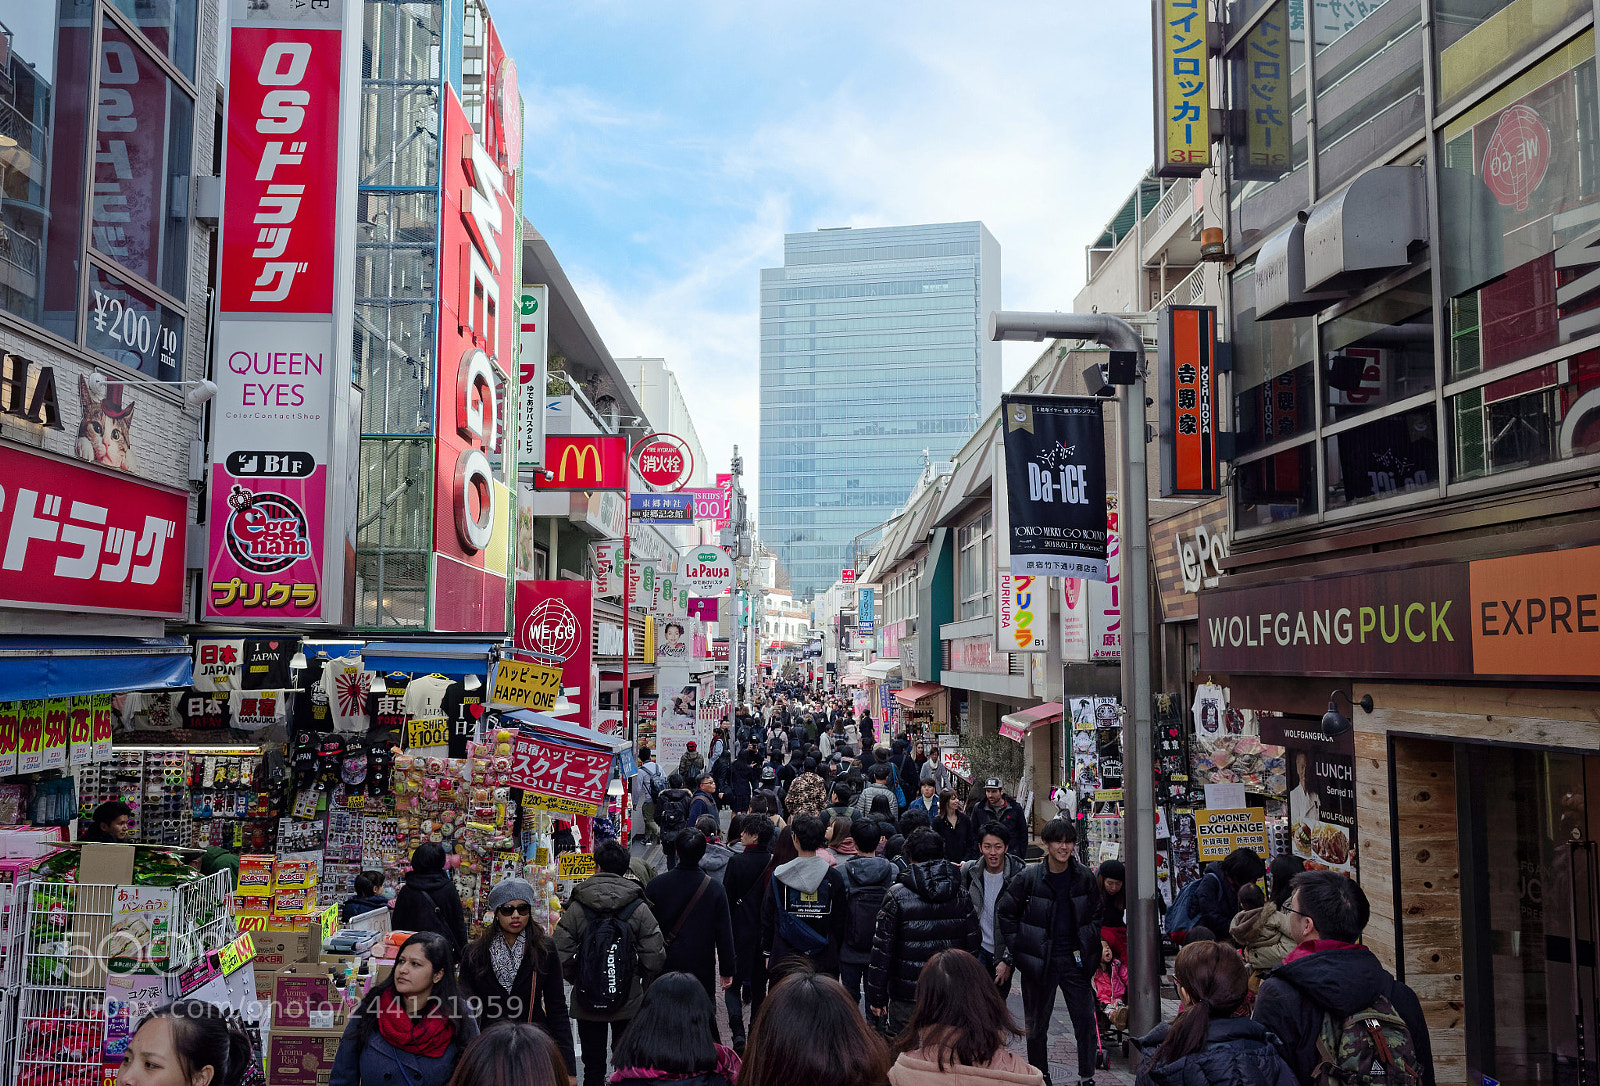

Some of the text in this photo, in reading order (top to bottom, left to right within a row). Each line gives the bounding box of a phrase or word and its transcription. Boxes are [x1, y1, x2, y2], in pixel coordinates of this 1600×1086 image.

[1170, 150, 1206, 163] 3F
[250, 42, 313, 302] OSドラッグ
[160, 352, 176, 368] min
[228, 351, 323, 375] QUEEN
[242, 383, 305, 407] EYES
[1177, 363, 1197, 435] 吉野家
[1200, 365, 1210, 433] YOSHINOYA
[263, 455, 303, 474] B1F
[642, 454, 681, 473] 消火栓
[1027, 461, 1089, 505] Da-iCE
[641, 499, 682, 508] 東郷神社
[641, 509, 684, 519] 東郷記念館
[1015, 526, 1042, 537] TOKYO
[1043, 527, 1061, 537] MERRY
[1063, 528, 1081, 538] GO
[1044, 540, 1078, 550] 2018.01.17
[1026, 561, 1098, 574] 原宿竹下通り商店会
[1001, 575, 1011, 629] PURIKURA
[1208, 600, 1455, 648] WOLFGANG PUCK
[1034, 638, 1045, 647] B1
[200, 644, 238, 665] 日本
[251, 652, 280, 662] JAPAN
[200, 665, 237, 676] JAPAN
[499, 664, 560, 689] ハッピーワン
[187, 697, 223, 717] 日本
[494, 685, 557, 709] HAPPY ONE
[239, 698, 276, 717] 原宿
[238, 716, 276, 724] HARAJUKU
[516, 741, 609, 768] 原宿ハッピーワン
[513, 754, 608, 791] スクイーズ
[1315, 762, 1353, 782] LUNCH
[510, 773, 604, 800] SQUEEZE
[1218, 813, 1252, 823] MONEY
[1199, 823, 1264, 835] EXCHANGE
[606, 942, 618, 994] Supreme
